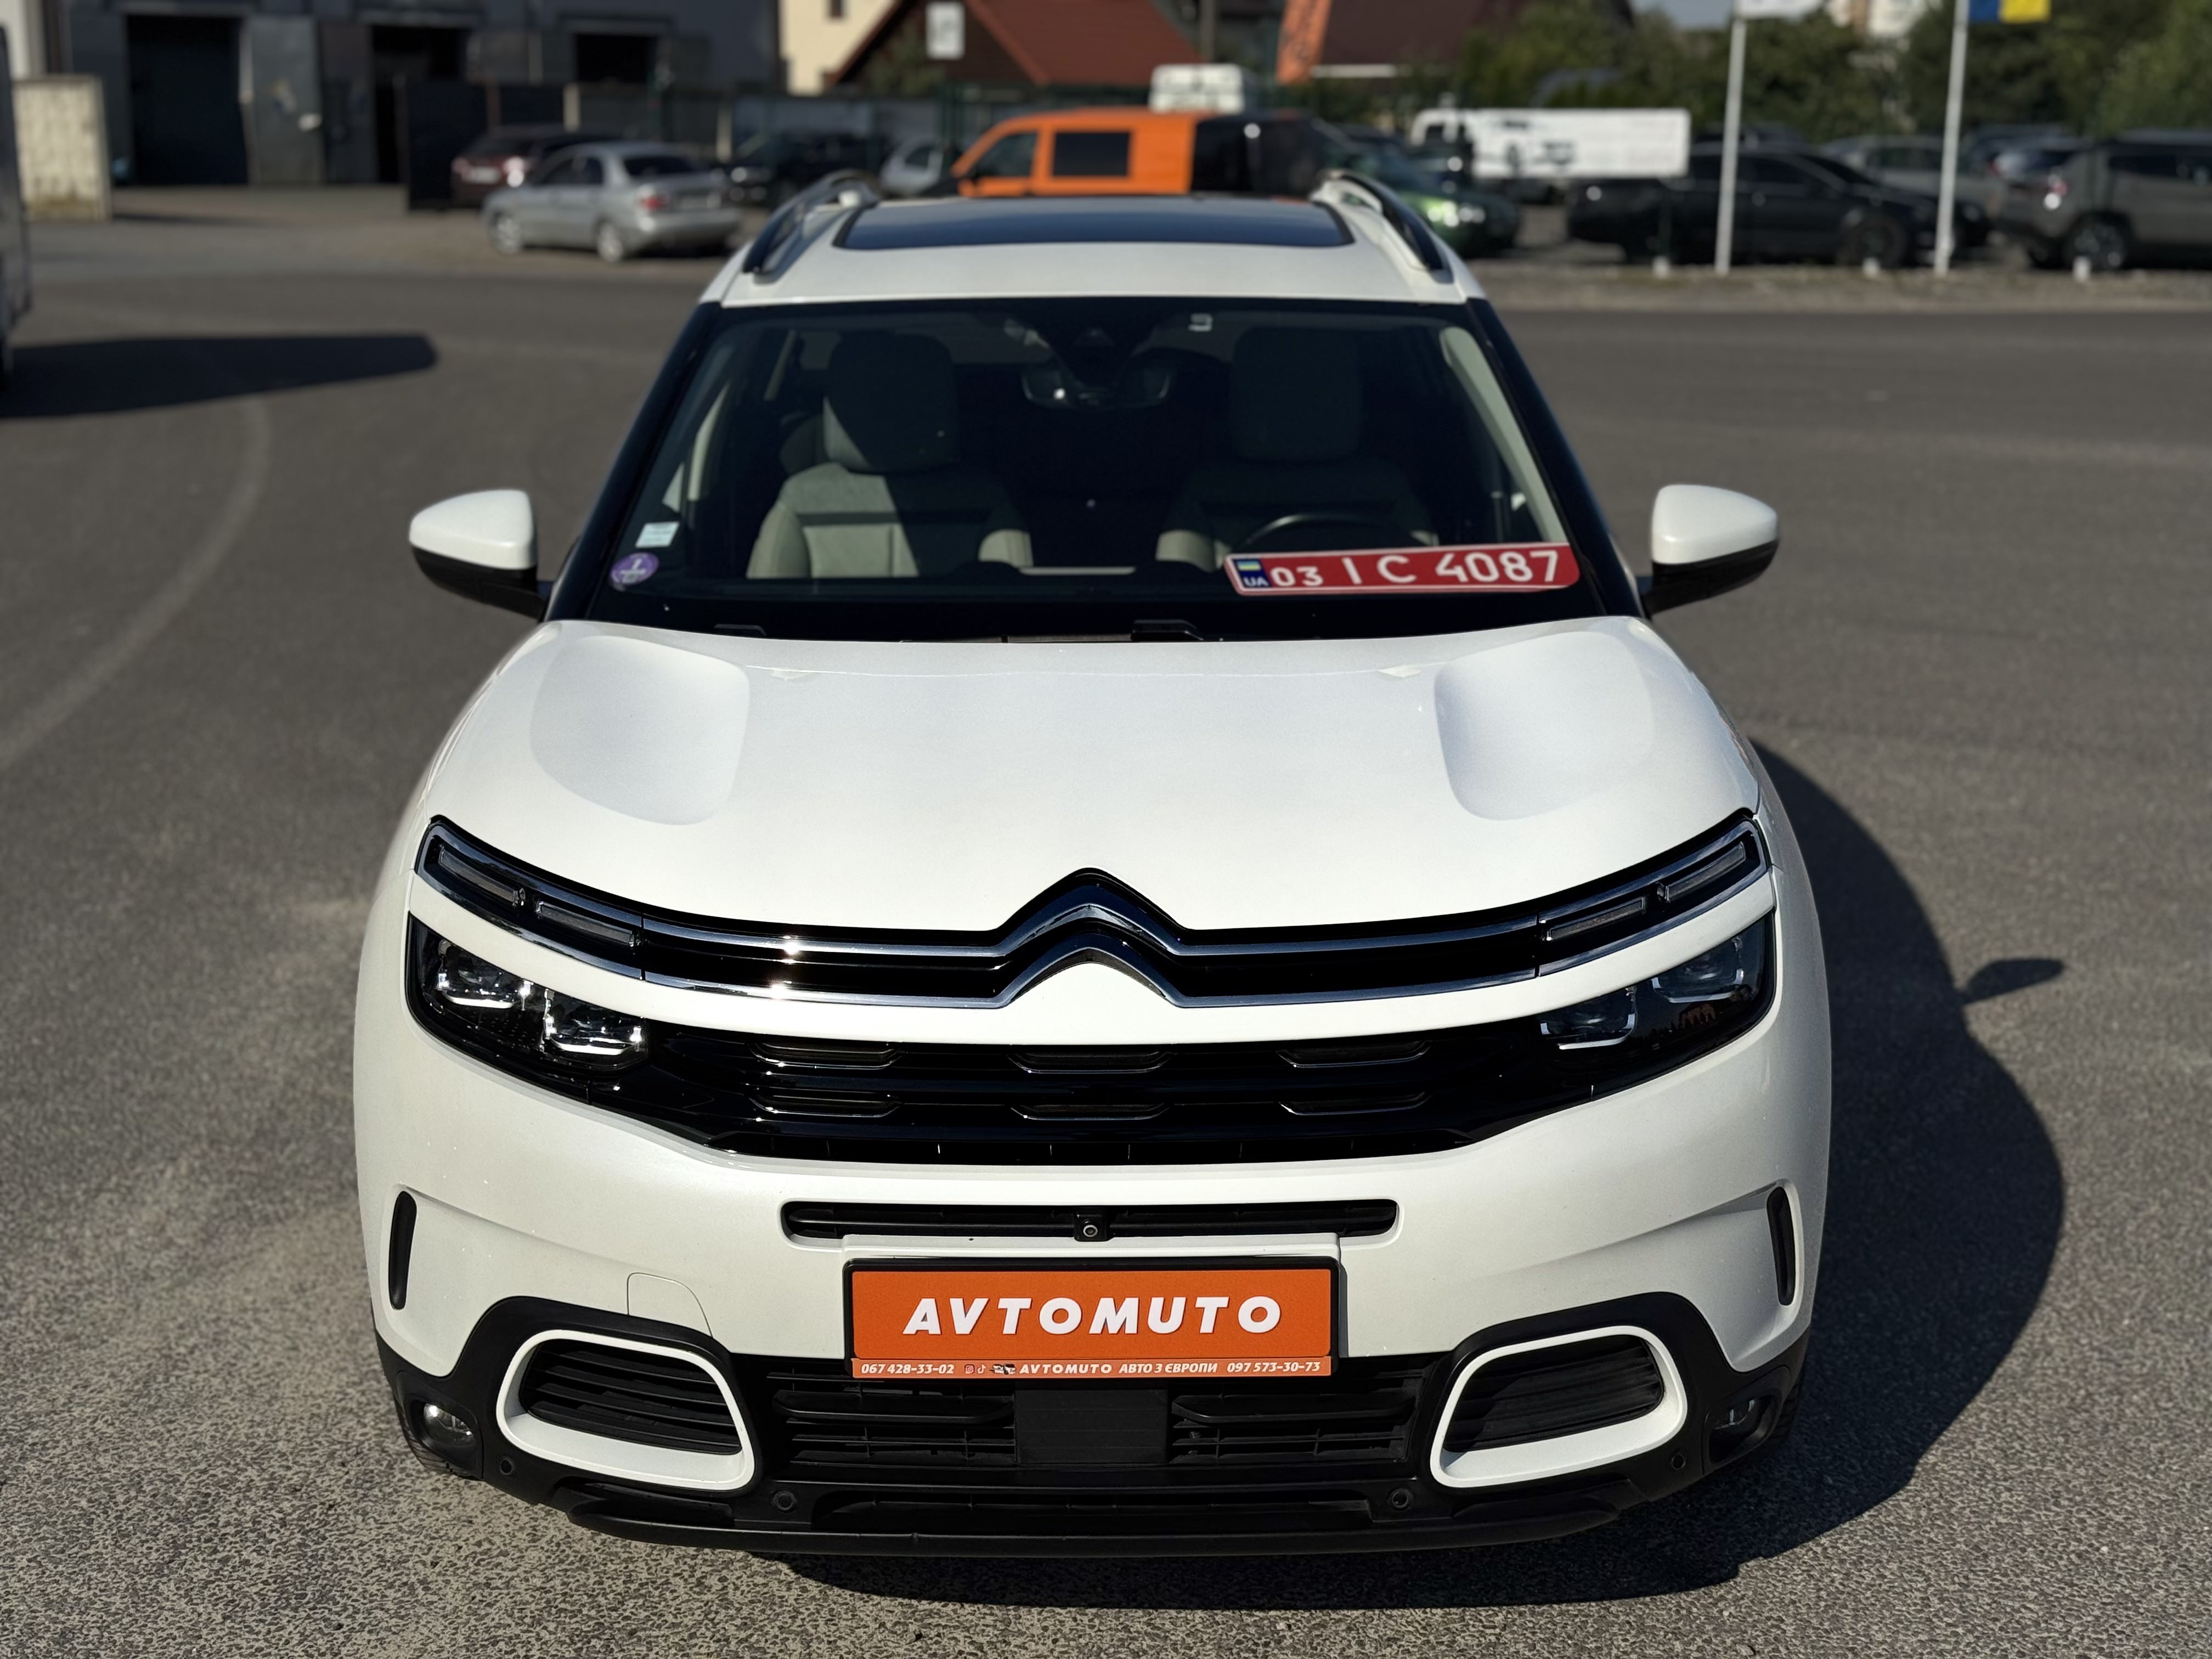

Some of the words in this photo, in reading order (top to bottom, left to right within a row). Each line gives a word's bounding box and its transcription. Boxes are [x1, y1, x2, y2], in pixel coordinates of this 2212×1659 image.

[1270, 566, 1323, 586] 03
[1435, 550, 1558, 582] 4087
[1243, 577, 1269, 586] UA
[902, 1296, 1282, 1335] AVTOMUTO
[861, 1363, 885, 1374] 067
[887, 1363, 955, 1374] 428-33-02
[1019, 1364, 1112, 1374] AVTOMUTO
[1118, 1363, 1153, 1374] АВТО
[1227, 1362, 1251, 1373] 097
[1252, 1361, 1321, 1373] 573-30-73
